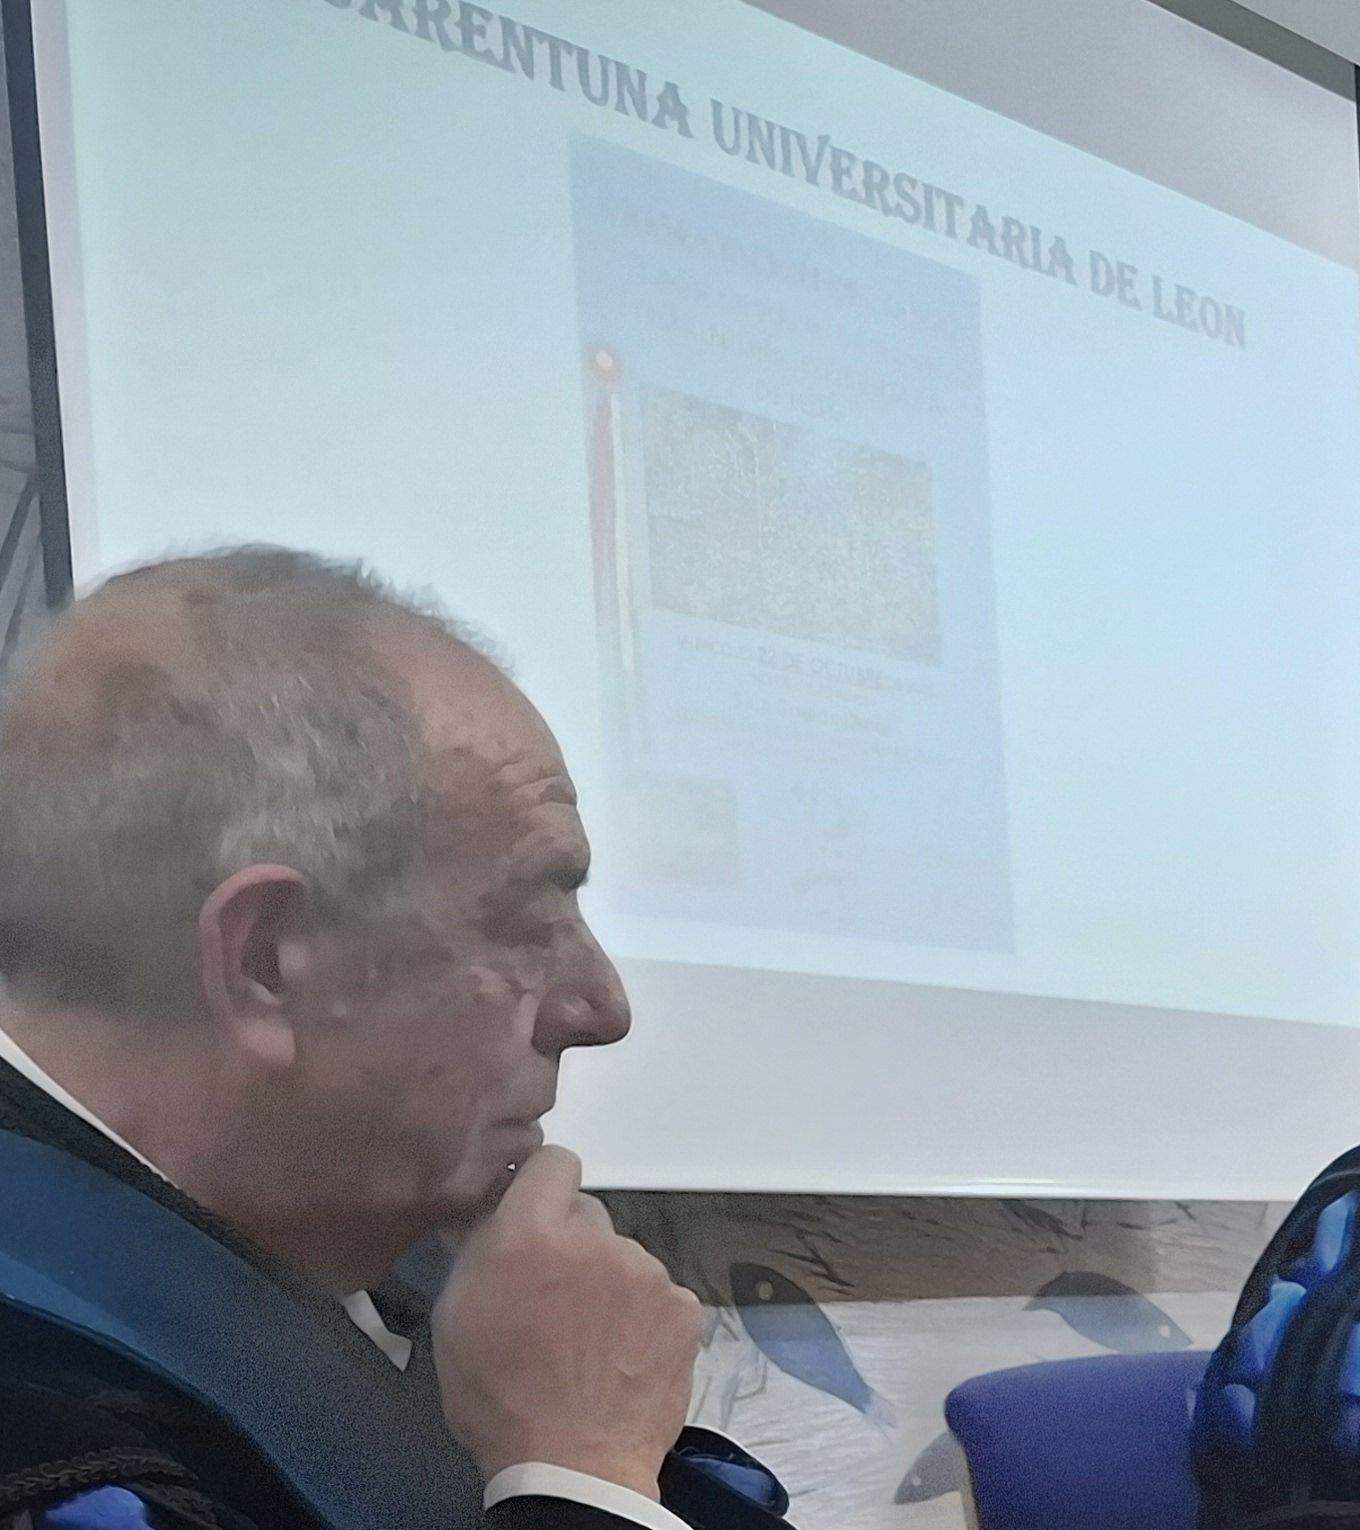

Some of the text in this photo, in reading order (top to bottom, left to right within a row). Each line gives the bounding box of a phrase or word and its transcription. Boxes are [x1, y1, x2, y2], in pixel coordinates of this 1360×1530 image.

[324, 0, 695, 138] ARENTUNA
[710, 98, 1078, 286] UNIVERSITARIA
[1088, 250, 1144, 311] DE
[1151, 275, 1247, 349] LEON
